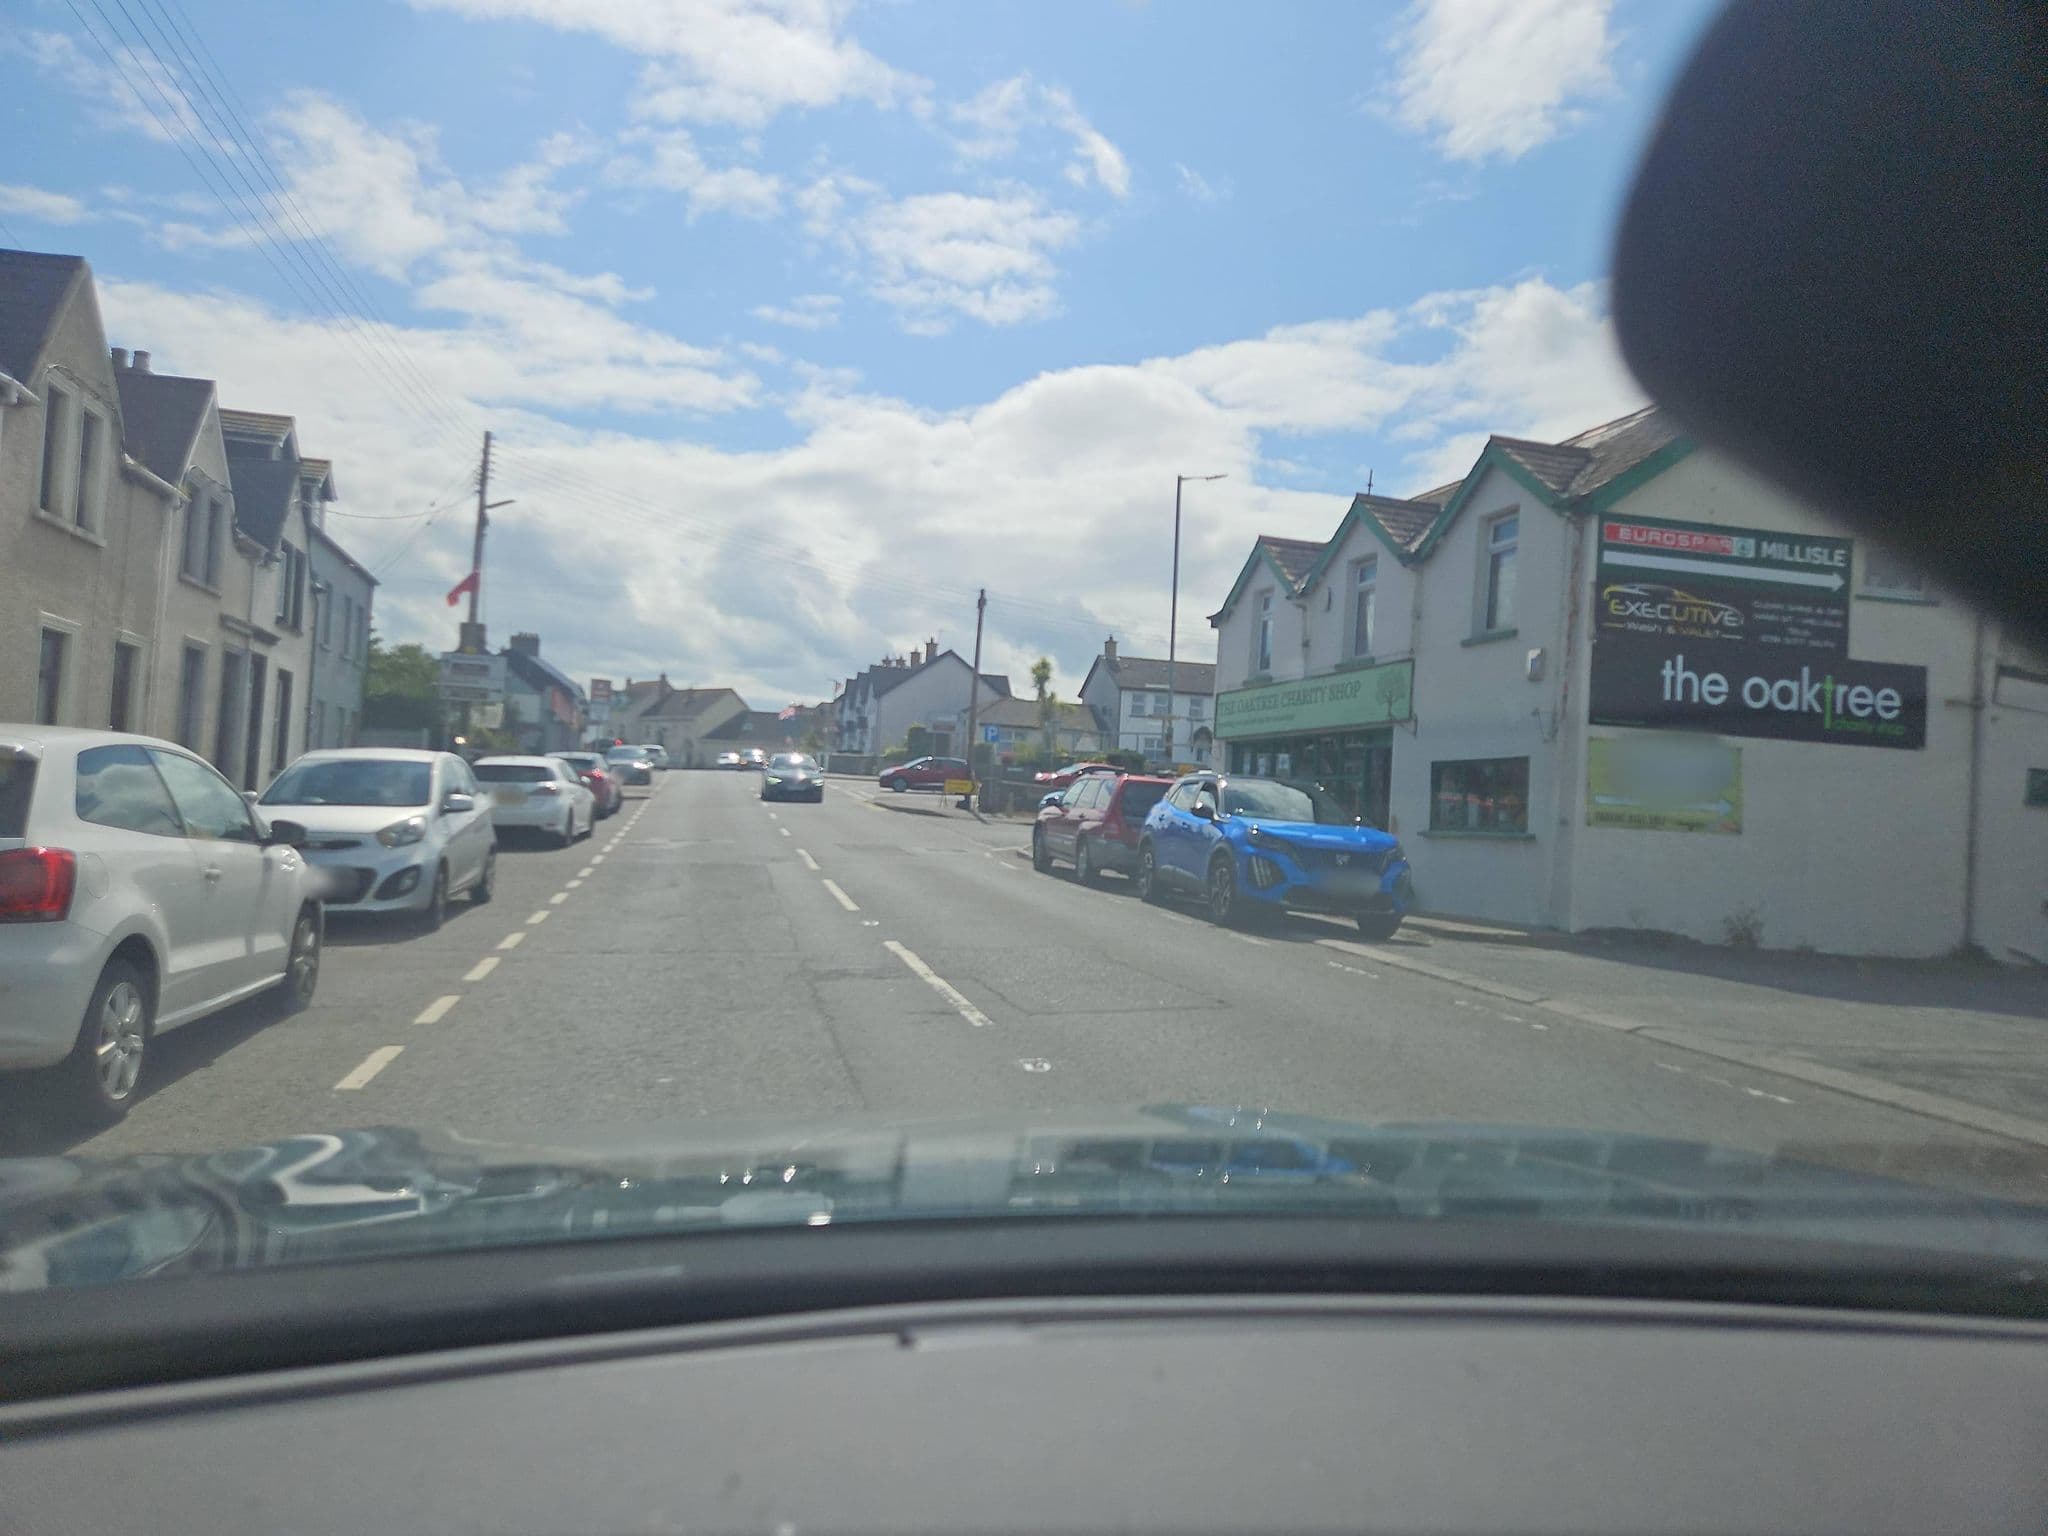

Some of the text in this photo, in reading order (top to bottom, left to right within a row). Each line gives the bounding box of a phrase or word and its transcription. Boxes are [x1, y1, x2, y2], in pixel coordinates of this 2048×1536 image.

[1618, 526, 1848, 567] EUROSPAR MILLISLE
[1609, 598, 1739, 627] EXECUTIVE
[1281, 685, 1327, 708] CHARITY
[1328, 679, 1362, 703] SHOP
[1660, 653, 1902, 731] the oaktree
[986, 727, 998, 741] P
